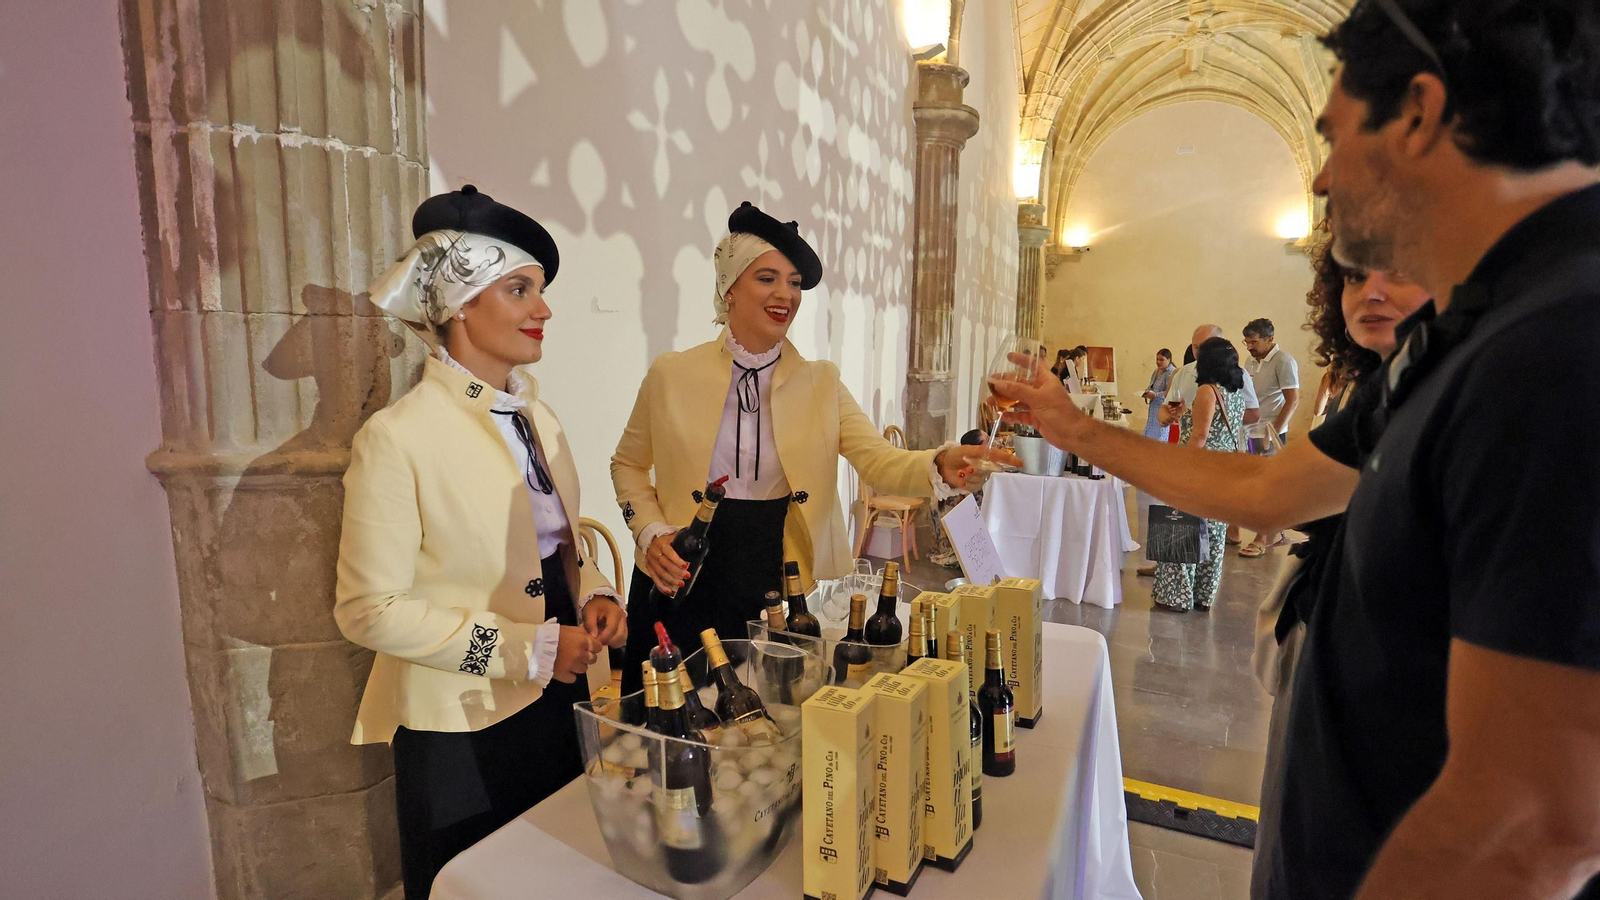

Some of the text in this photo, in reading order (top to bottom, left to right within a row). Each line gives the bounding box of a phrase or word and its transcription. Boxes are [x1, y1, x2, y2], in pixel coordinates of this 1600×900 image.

[935, 670, 948, 678] do
[896, 687, 911, 696] do
[840, 700, 856, 710] do
[826, 751, 834, 762] CIA
[877, 750, 887, 772] PINO
[823, 768, 834, 790] PINO
[876, 782, 886, 824] CAYETANO
[823, 801, 834, 845] CAYETANO
